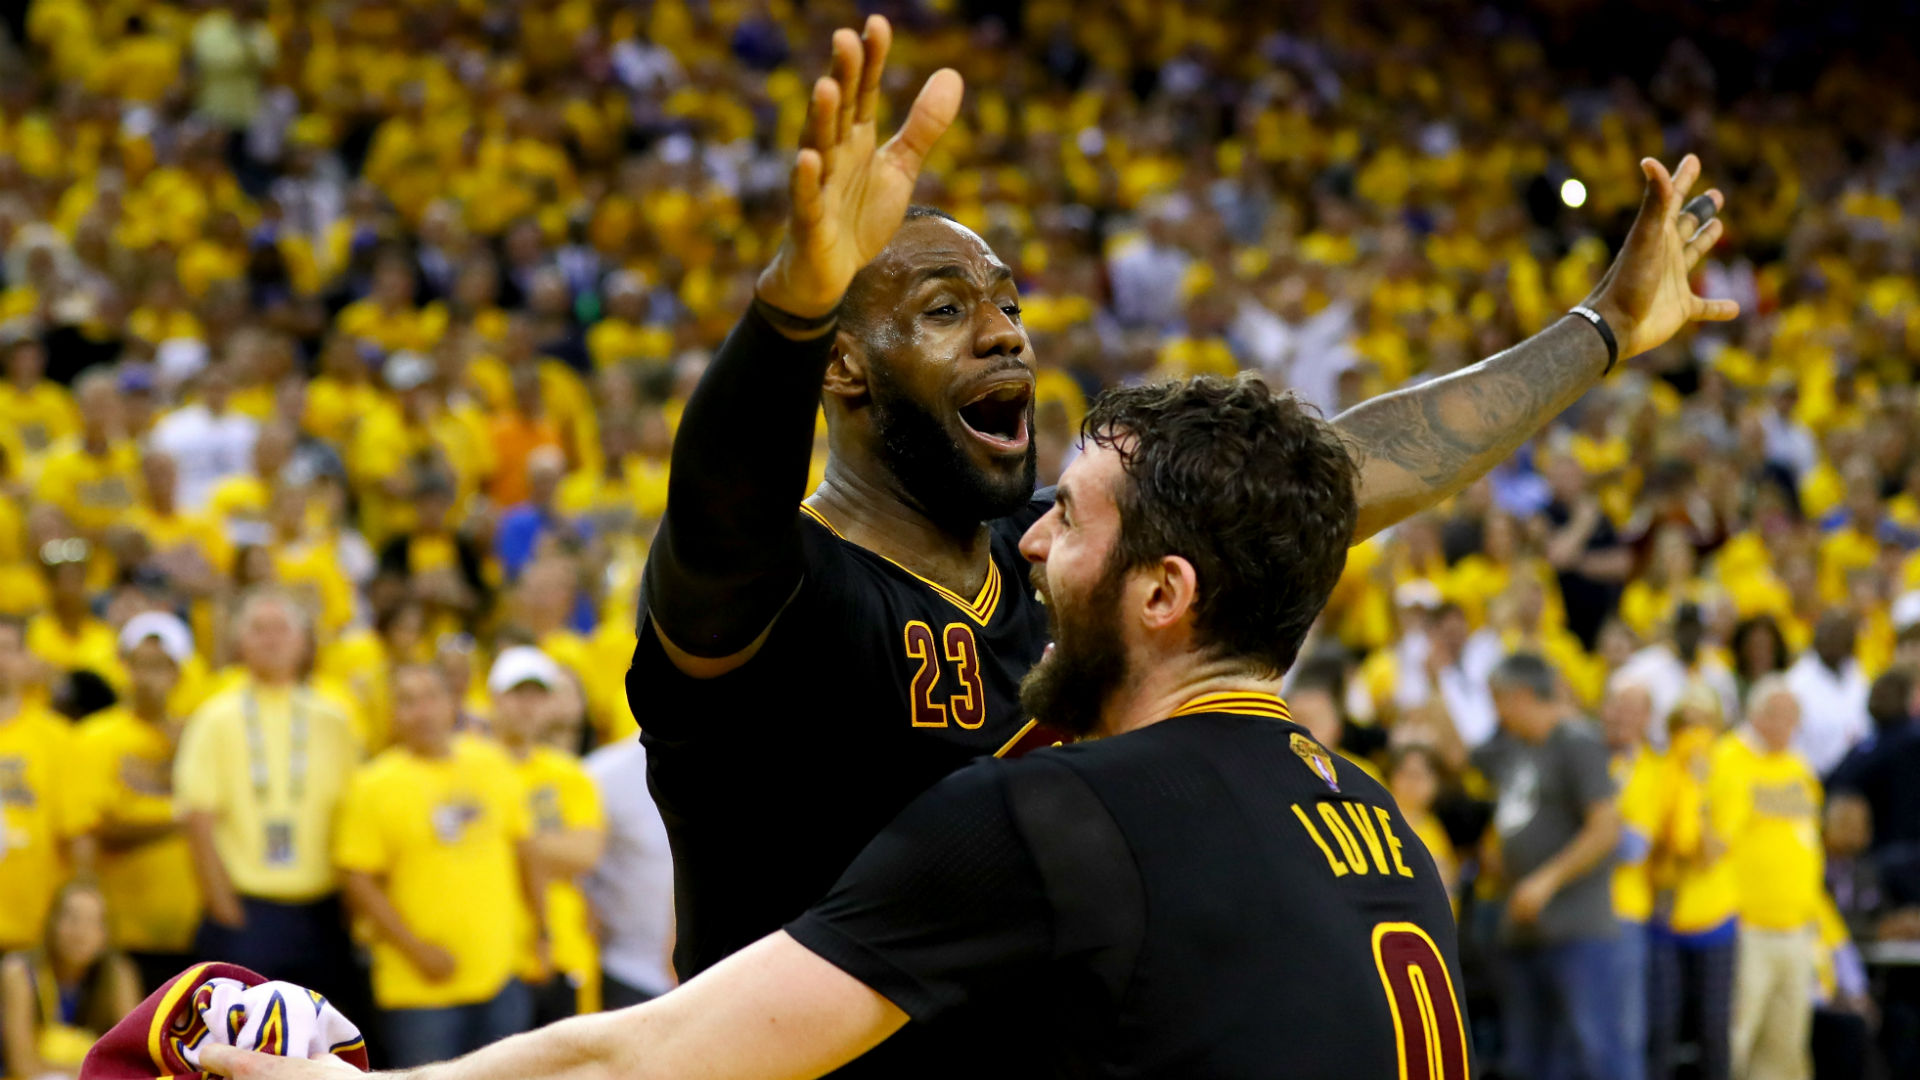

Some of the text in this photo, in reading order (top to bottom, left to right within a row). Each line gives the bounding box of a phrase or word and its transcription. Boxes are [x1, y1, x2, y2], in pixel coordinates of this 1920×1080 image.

[904, 620, 985, 730] 23
[1290, 801, 1414, 878] LOVE
[1371, 921, 1469, 1080] 0
